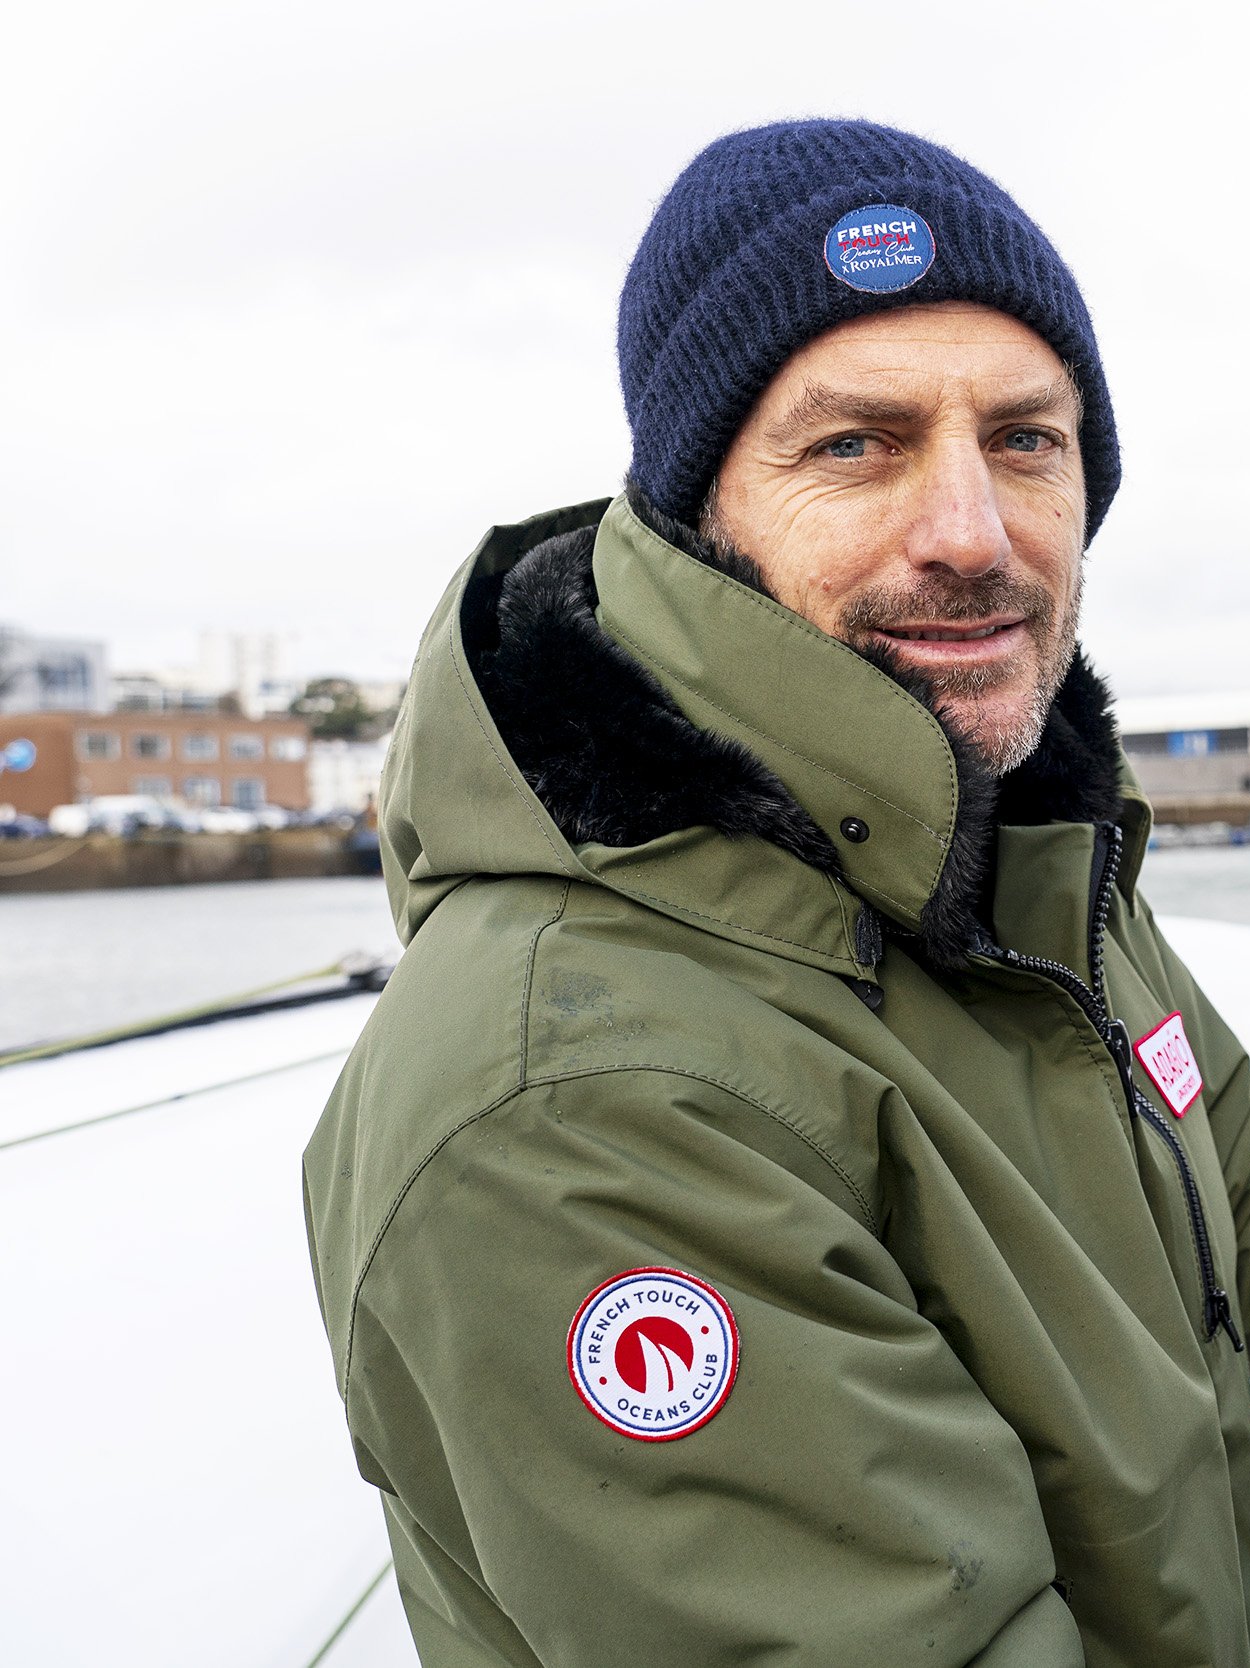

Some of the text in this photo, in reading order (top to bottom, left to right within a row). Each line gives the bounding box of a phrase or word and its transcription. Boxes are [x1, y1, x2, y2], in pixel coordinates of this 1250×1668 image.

[837, 221, 917, 242] FRENCH
[885, 242, 915, 257] Club
[588, 1290, 701, 1365] FRENCH TOUCH
[617, 1353, 718, 1422] OCEANS CLUB
